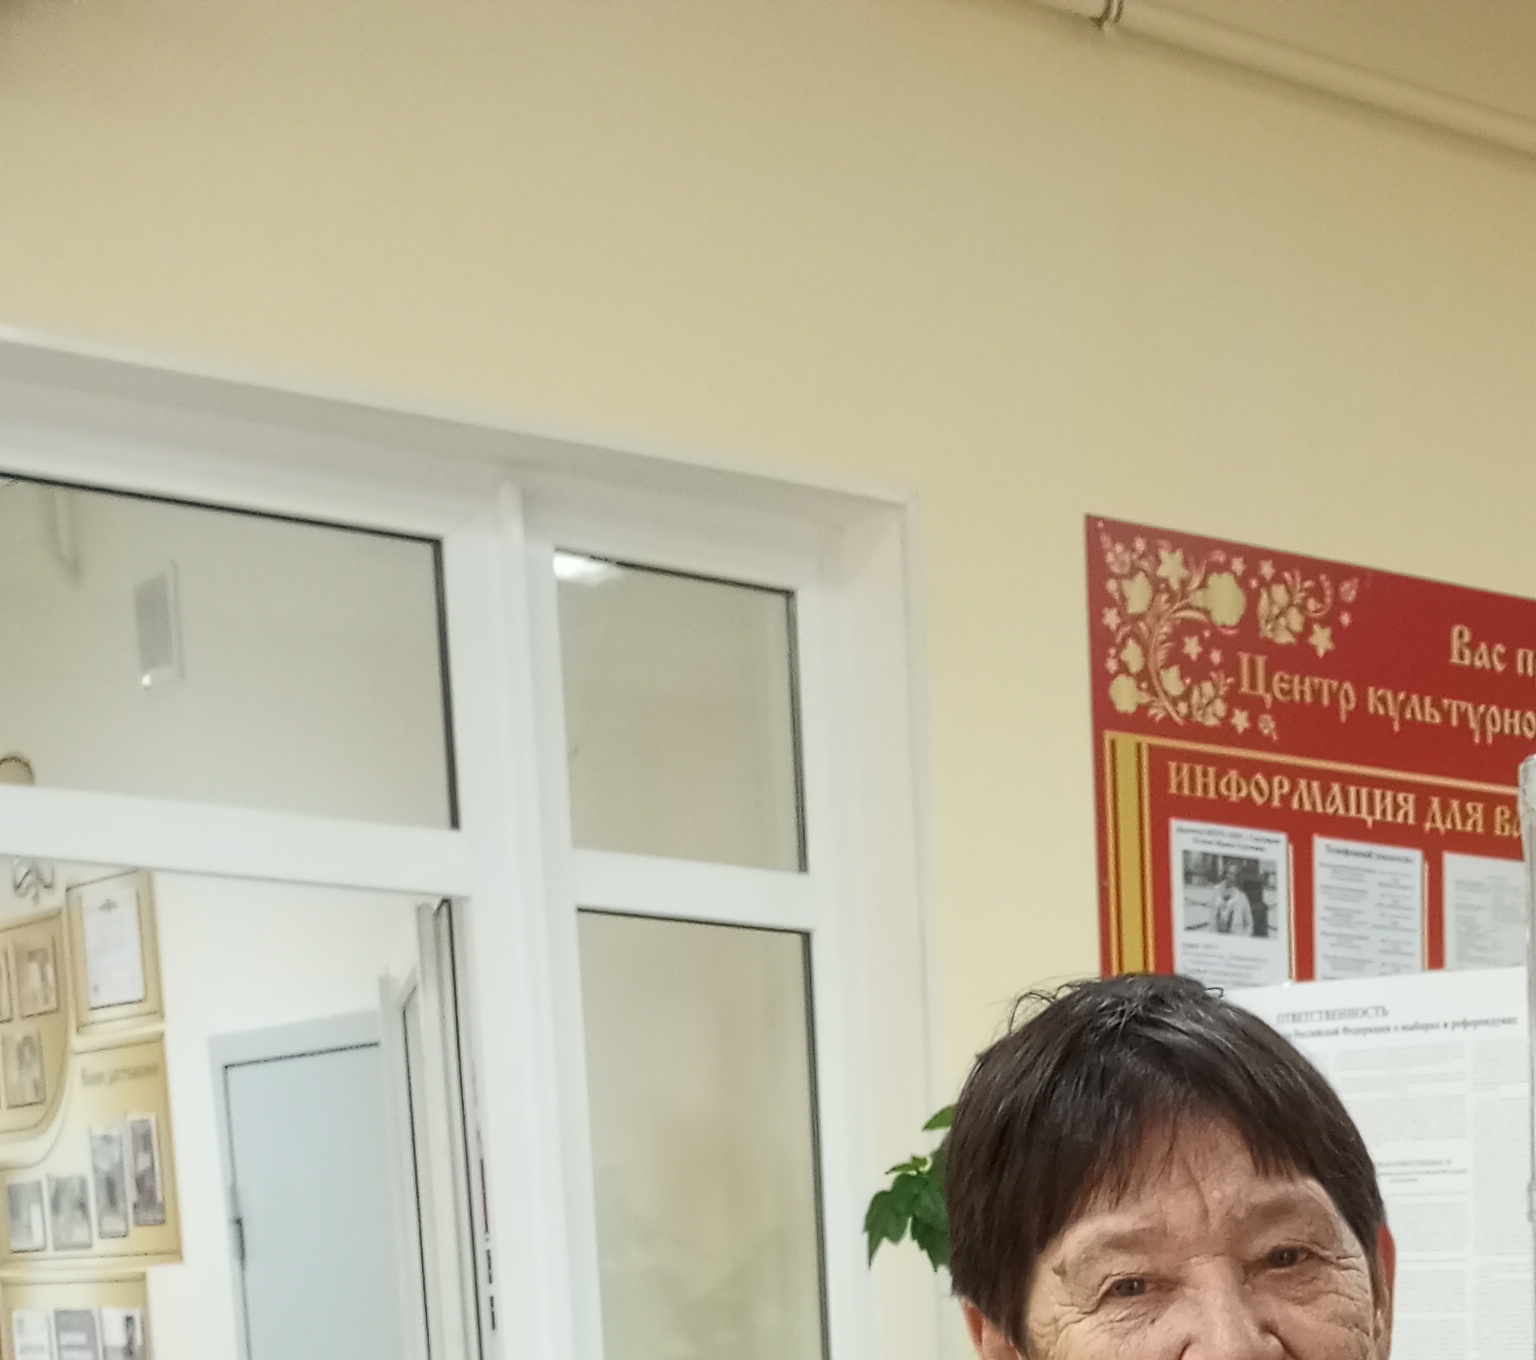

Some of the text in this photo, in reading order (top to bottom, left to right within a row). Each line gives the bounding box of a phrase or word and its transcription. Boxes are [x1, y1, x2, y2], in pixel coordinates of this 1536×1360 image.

[1449, 624, 1507, 673] Вас
[1238, 651, 1357, 724] Центр
[1168, 761, 1416, 829] ИНФОРМАЦИЯ
[1424, 795, 1485, 836] ДЛЯ
